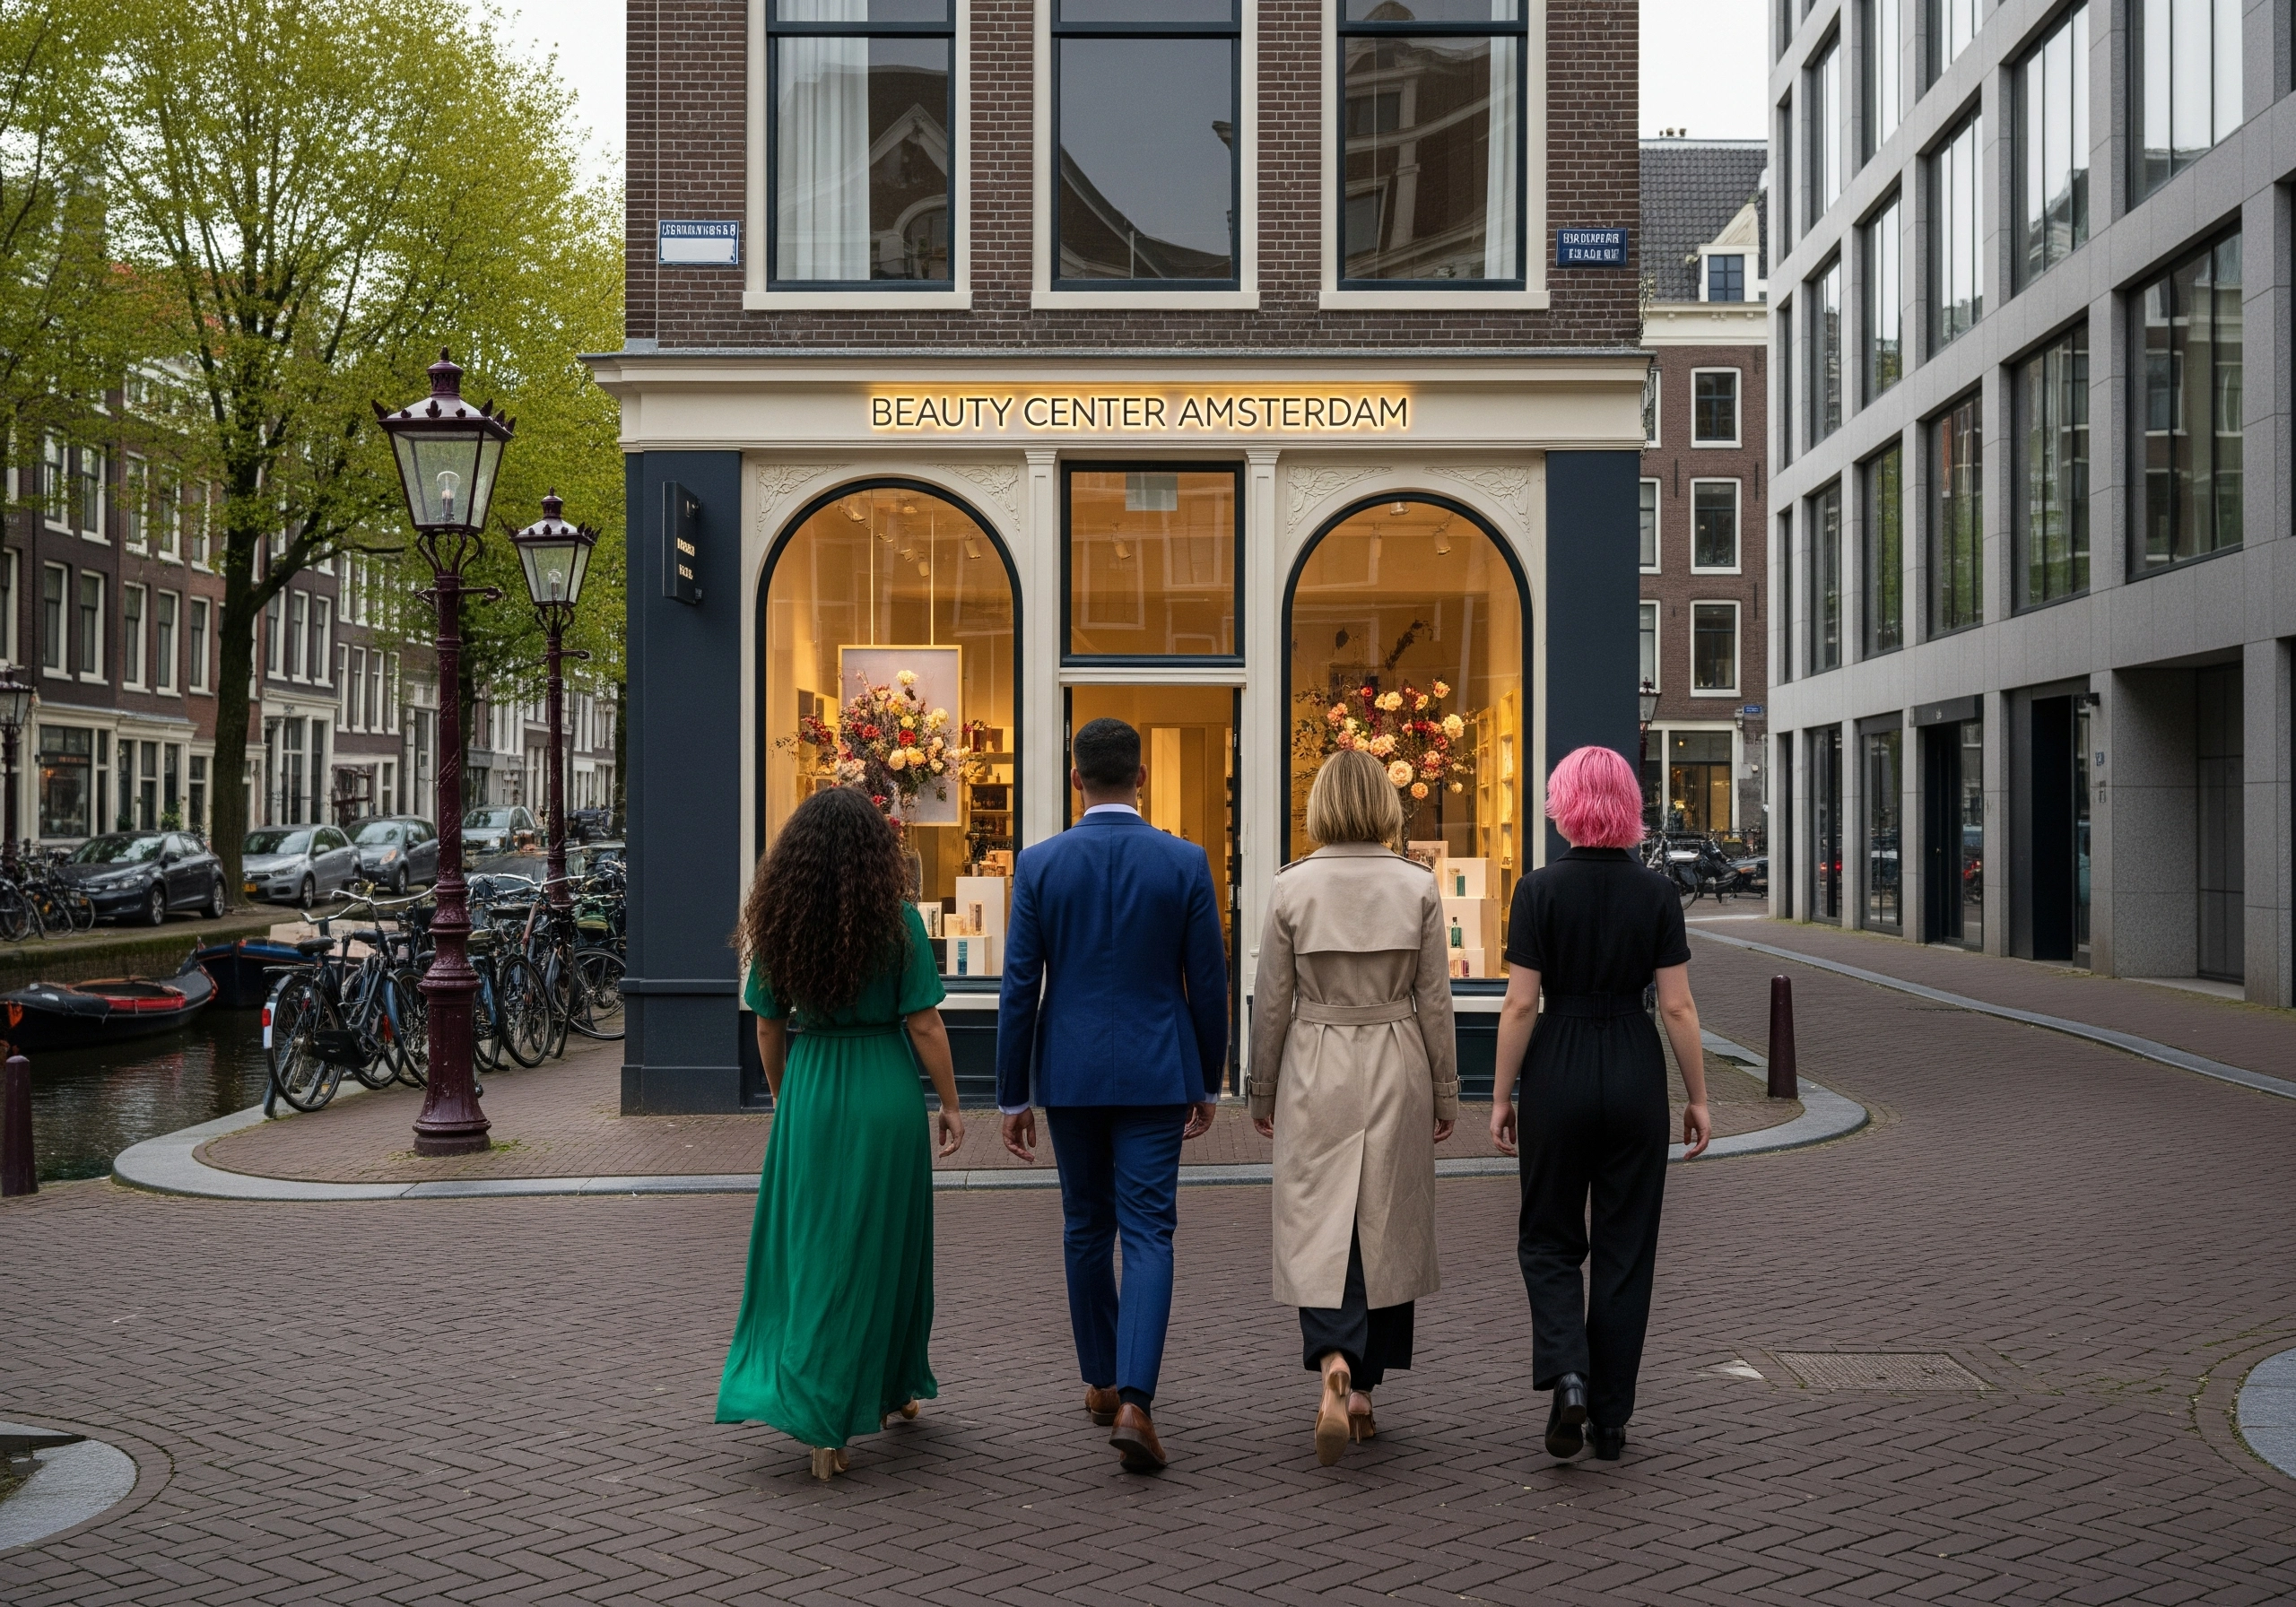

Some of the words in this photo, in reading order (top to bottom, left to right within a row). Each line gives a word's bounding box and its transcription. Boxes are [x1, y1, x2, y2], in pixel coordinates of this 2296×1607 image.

[873, 397, 1013, 427] BEAUTY
[1024, 396, 1166, 427] CENTER
[1178, 397, 1407, 427] AMSTERDAM
